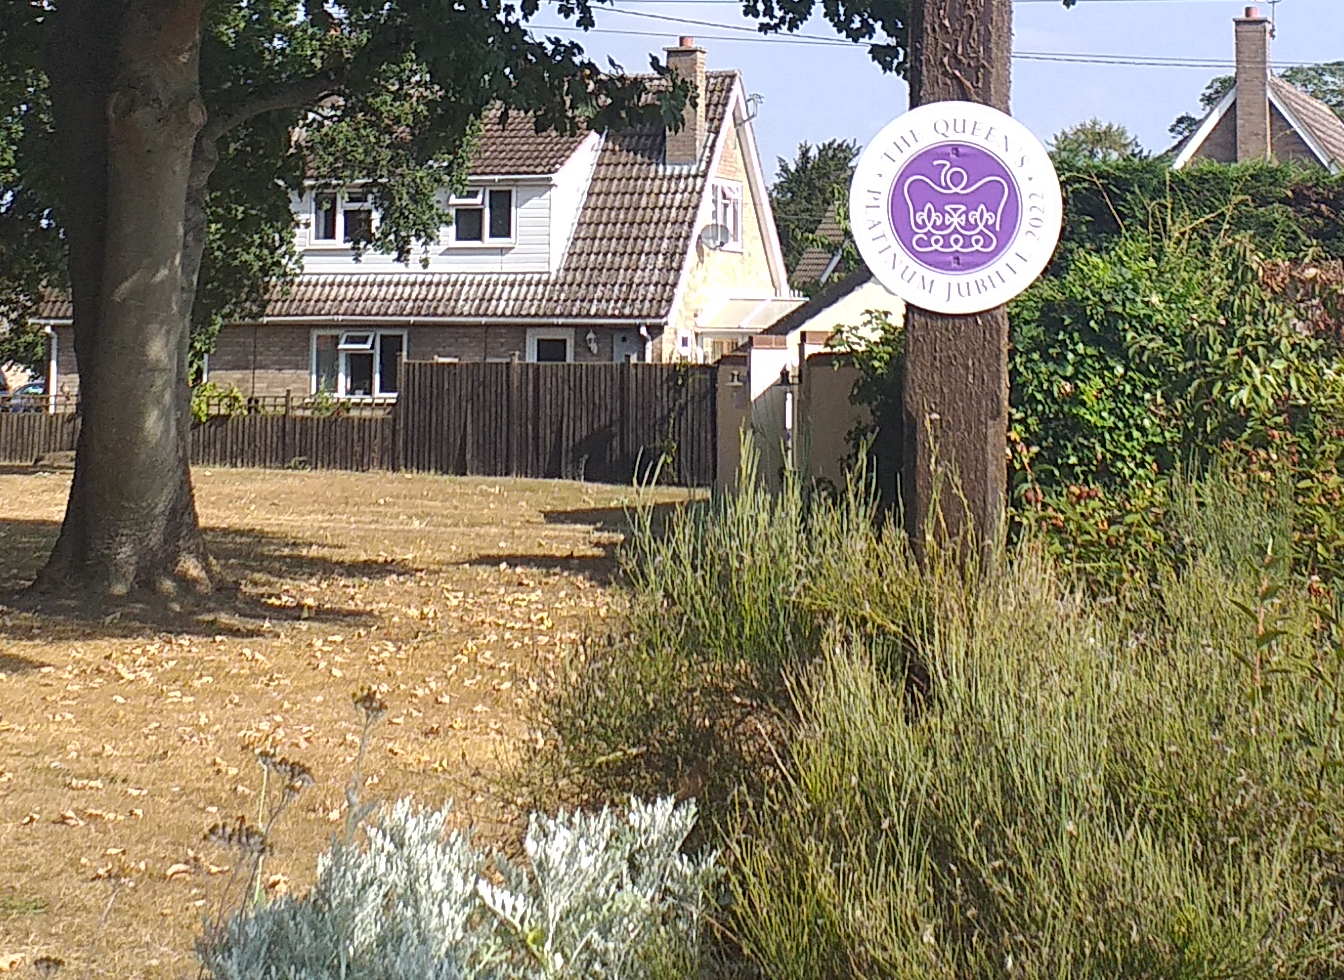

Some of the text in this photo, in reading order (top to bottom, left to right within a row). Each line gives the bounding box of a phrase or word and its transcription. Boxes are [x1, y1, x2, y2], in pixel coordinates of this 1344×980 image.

[881, 129, 924, 163] THE
[865, 189, 935, 294] PLATINUM
[1025, 191, 1045, 241] 2022
